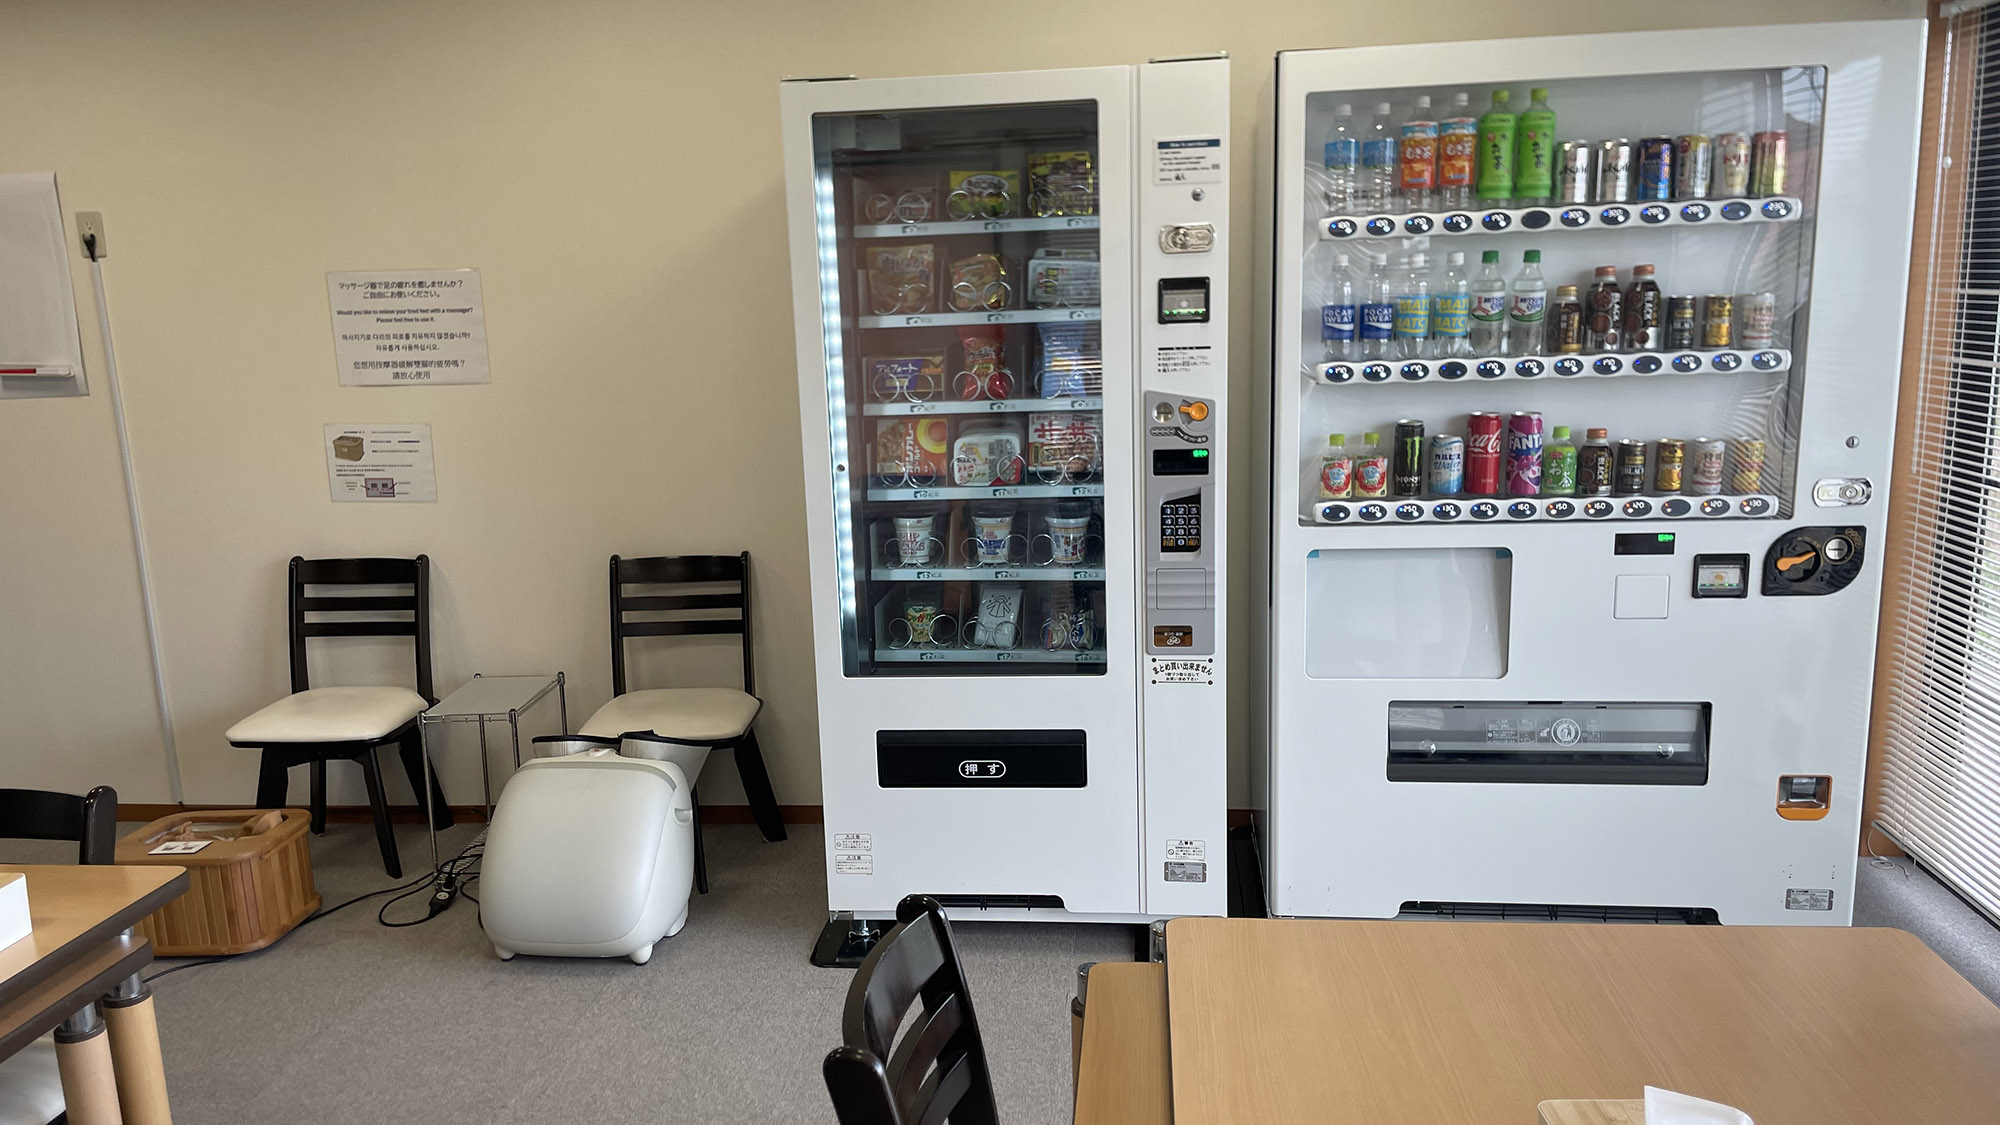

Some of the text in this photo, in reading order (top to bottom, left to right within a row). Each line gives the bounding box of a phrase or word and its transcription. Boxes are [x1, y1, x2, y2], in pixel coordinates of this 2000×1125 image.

[876, 364, 918, 372] アルフォート
[1152, 662, 1212, 676] まとめ買い出来ません
